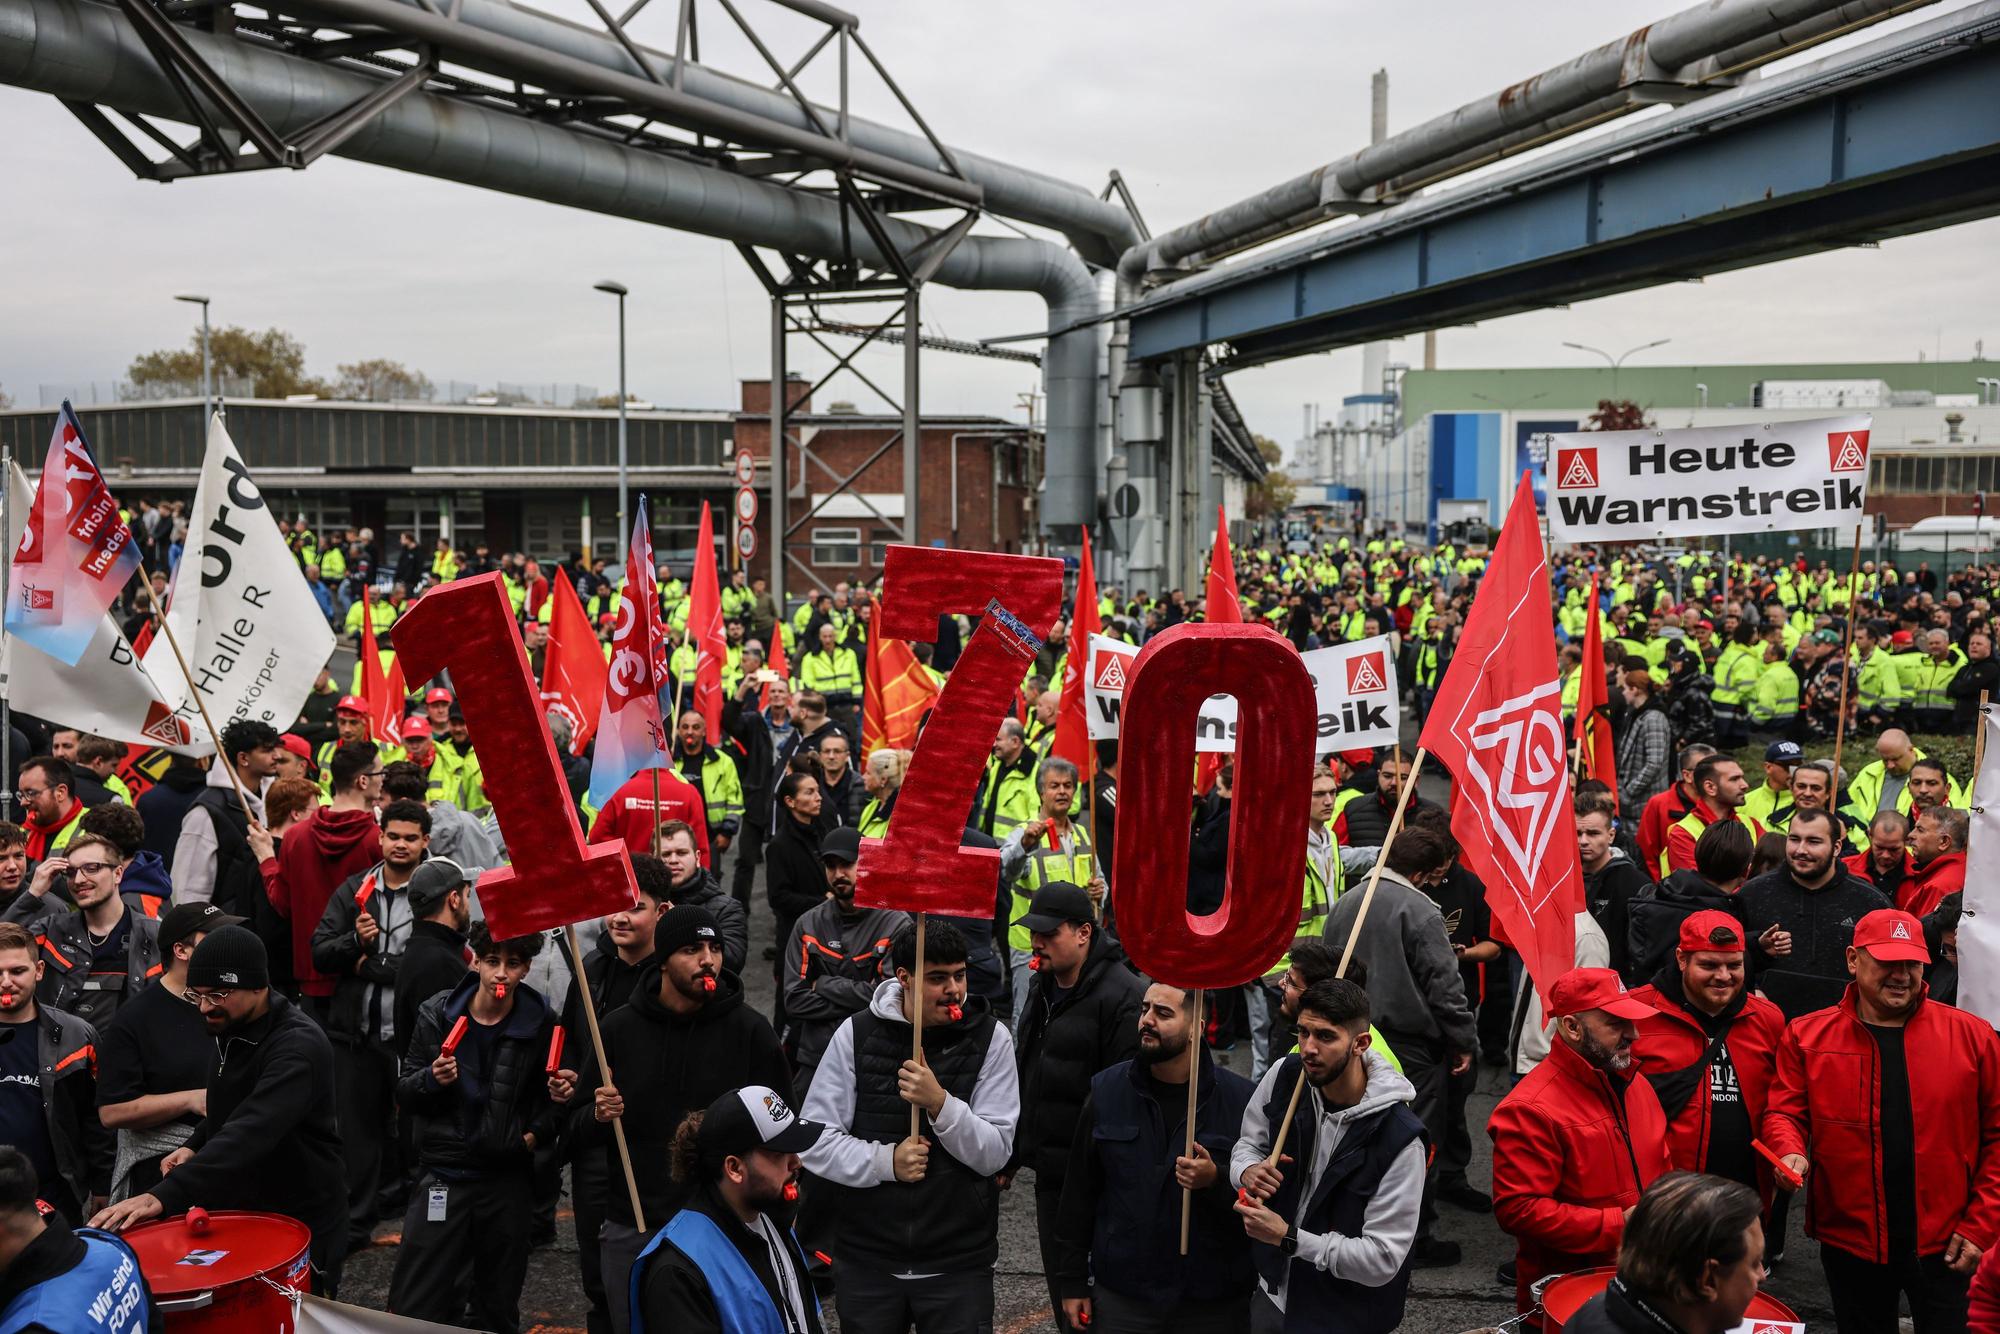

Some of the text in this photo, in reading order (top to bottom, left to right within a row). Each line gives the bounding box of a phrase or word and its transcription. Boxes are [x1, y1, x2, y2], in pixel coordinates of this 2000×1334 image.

[1629, 438, 1796, 476] Heute
[1557, 478, 1863, 526] Warnstreik
[194, 617, 255, 695] Halle
[1711, 1093, 1738, 1101] NDON
[87, 1252, 135, 1326] Wir sind
[108, 1281, 142, 1334] FORD
